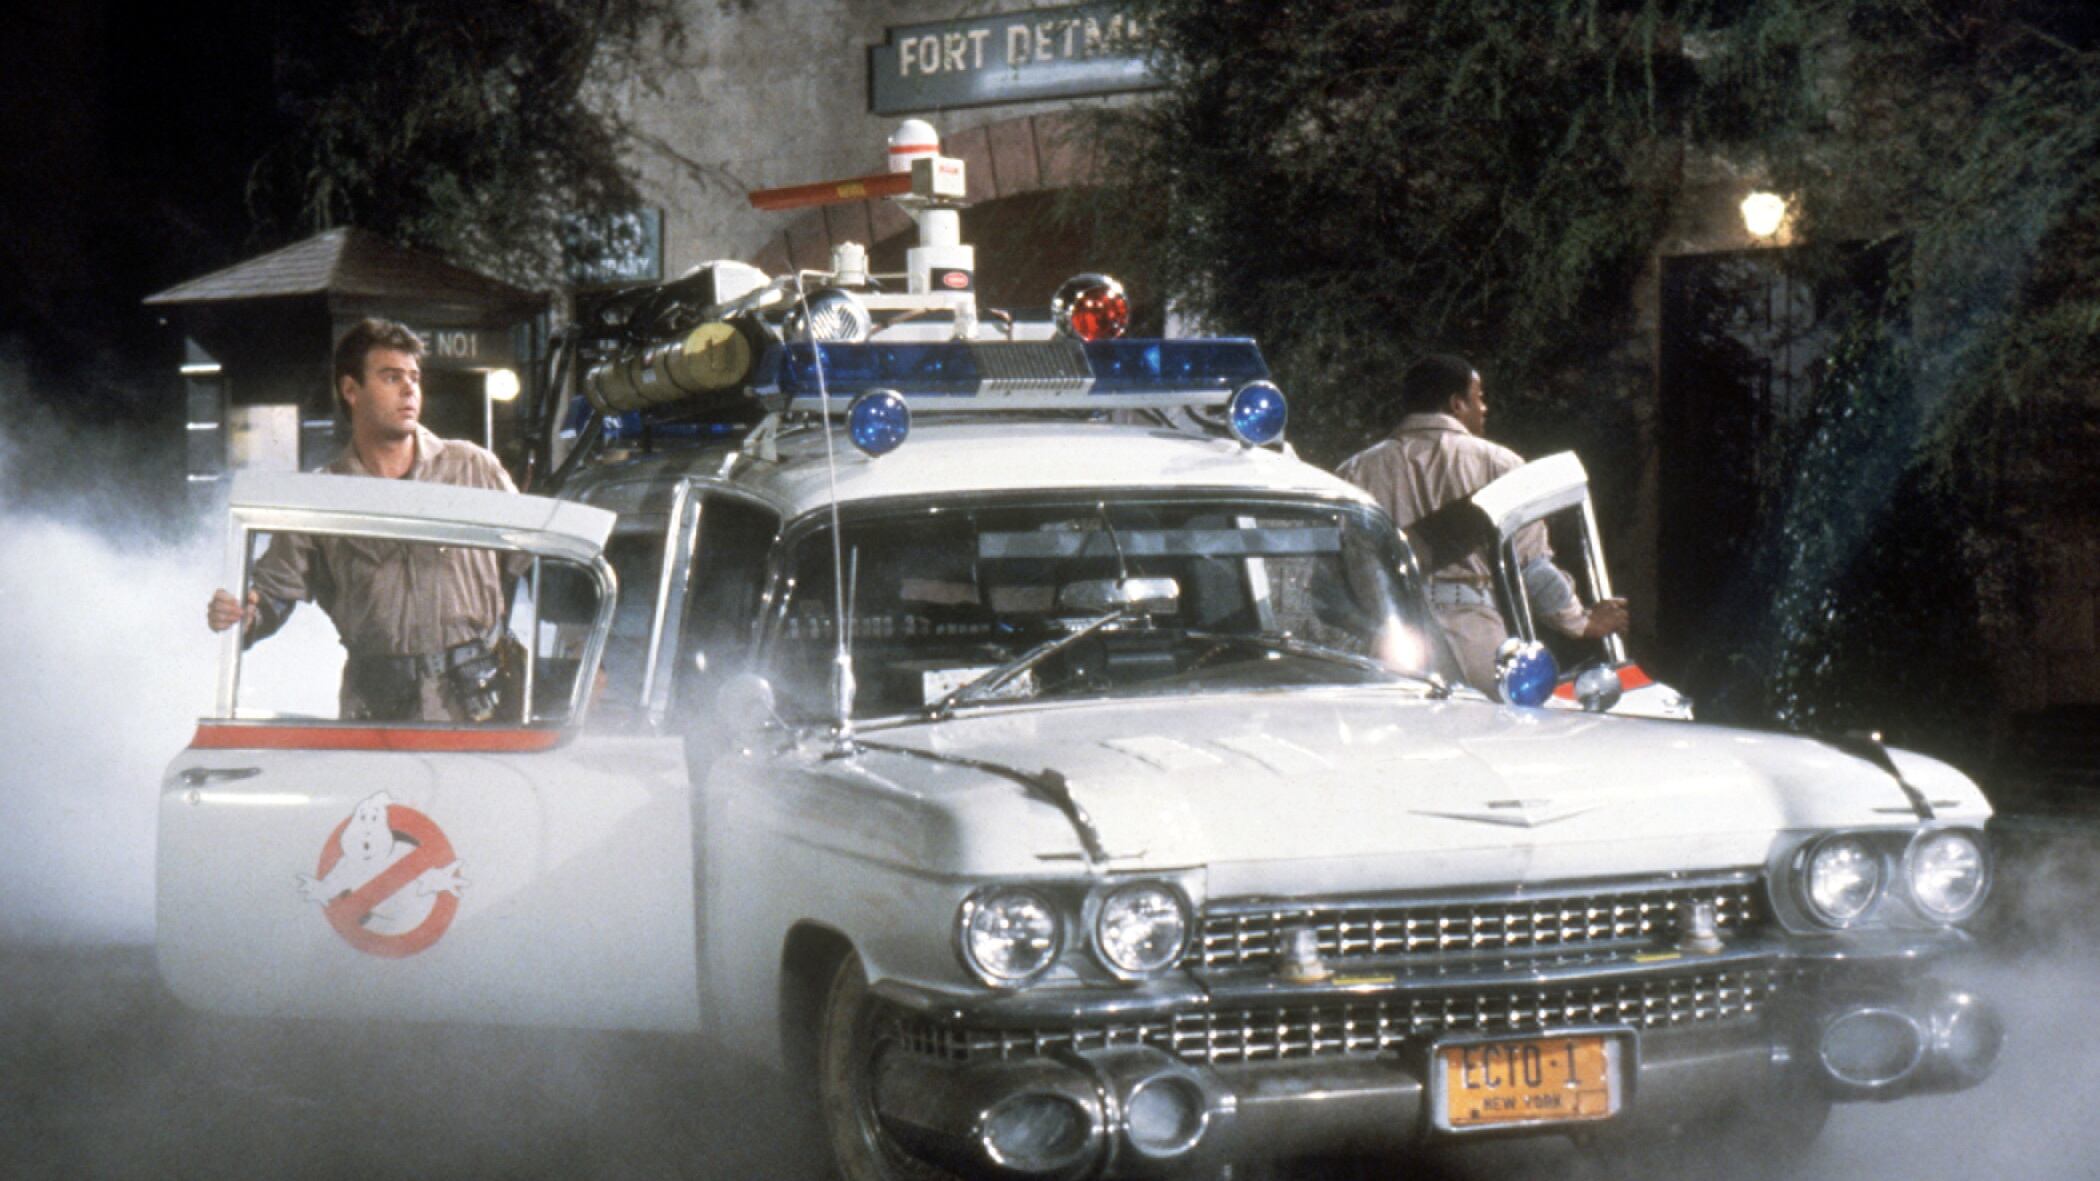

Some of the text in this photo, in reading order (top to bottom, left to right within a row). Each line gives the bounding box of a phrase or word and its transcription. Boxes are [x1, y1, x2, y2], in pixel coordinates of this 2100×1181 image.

[900, 29, 991, 76] FORT
[1484, 1094, 1561, 1110] NEW YORK
